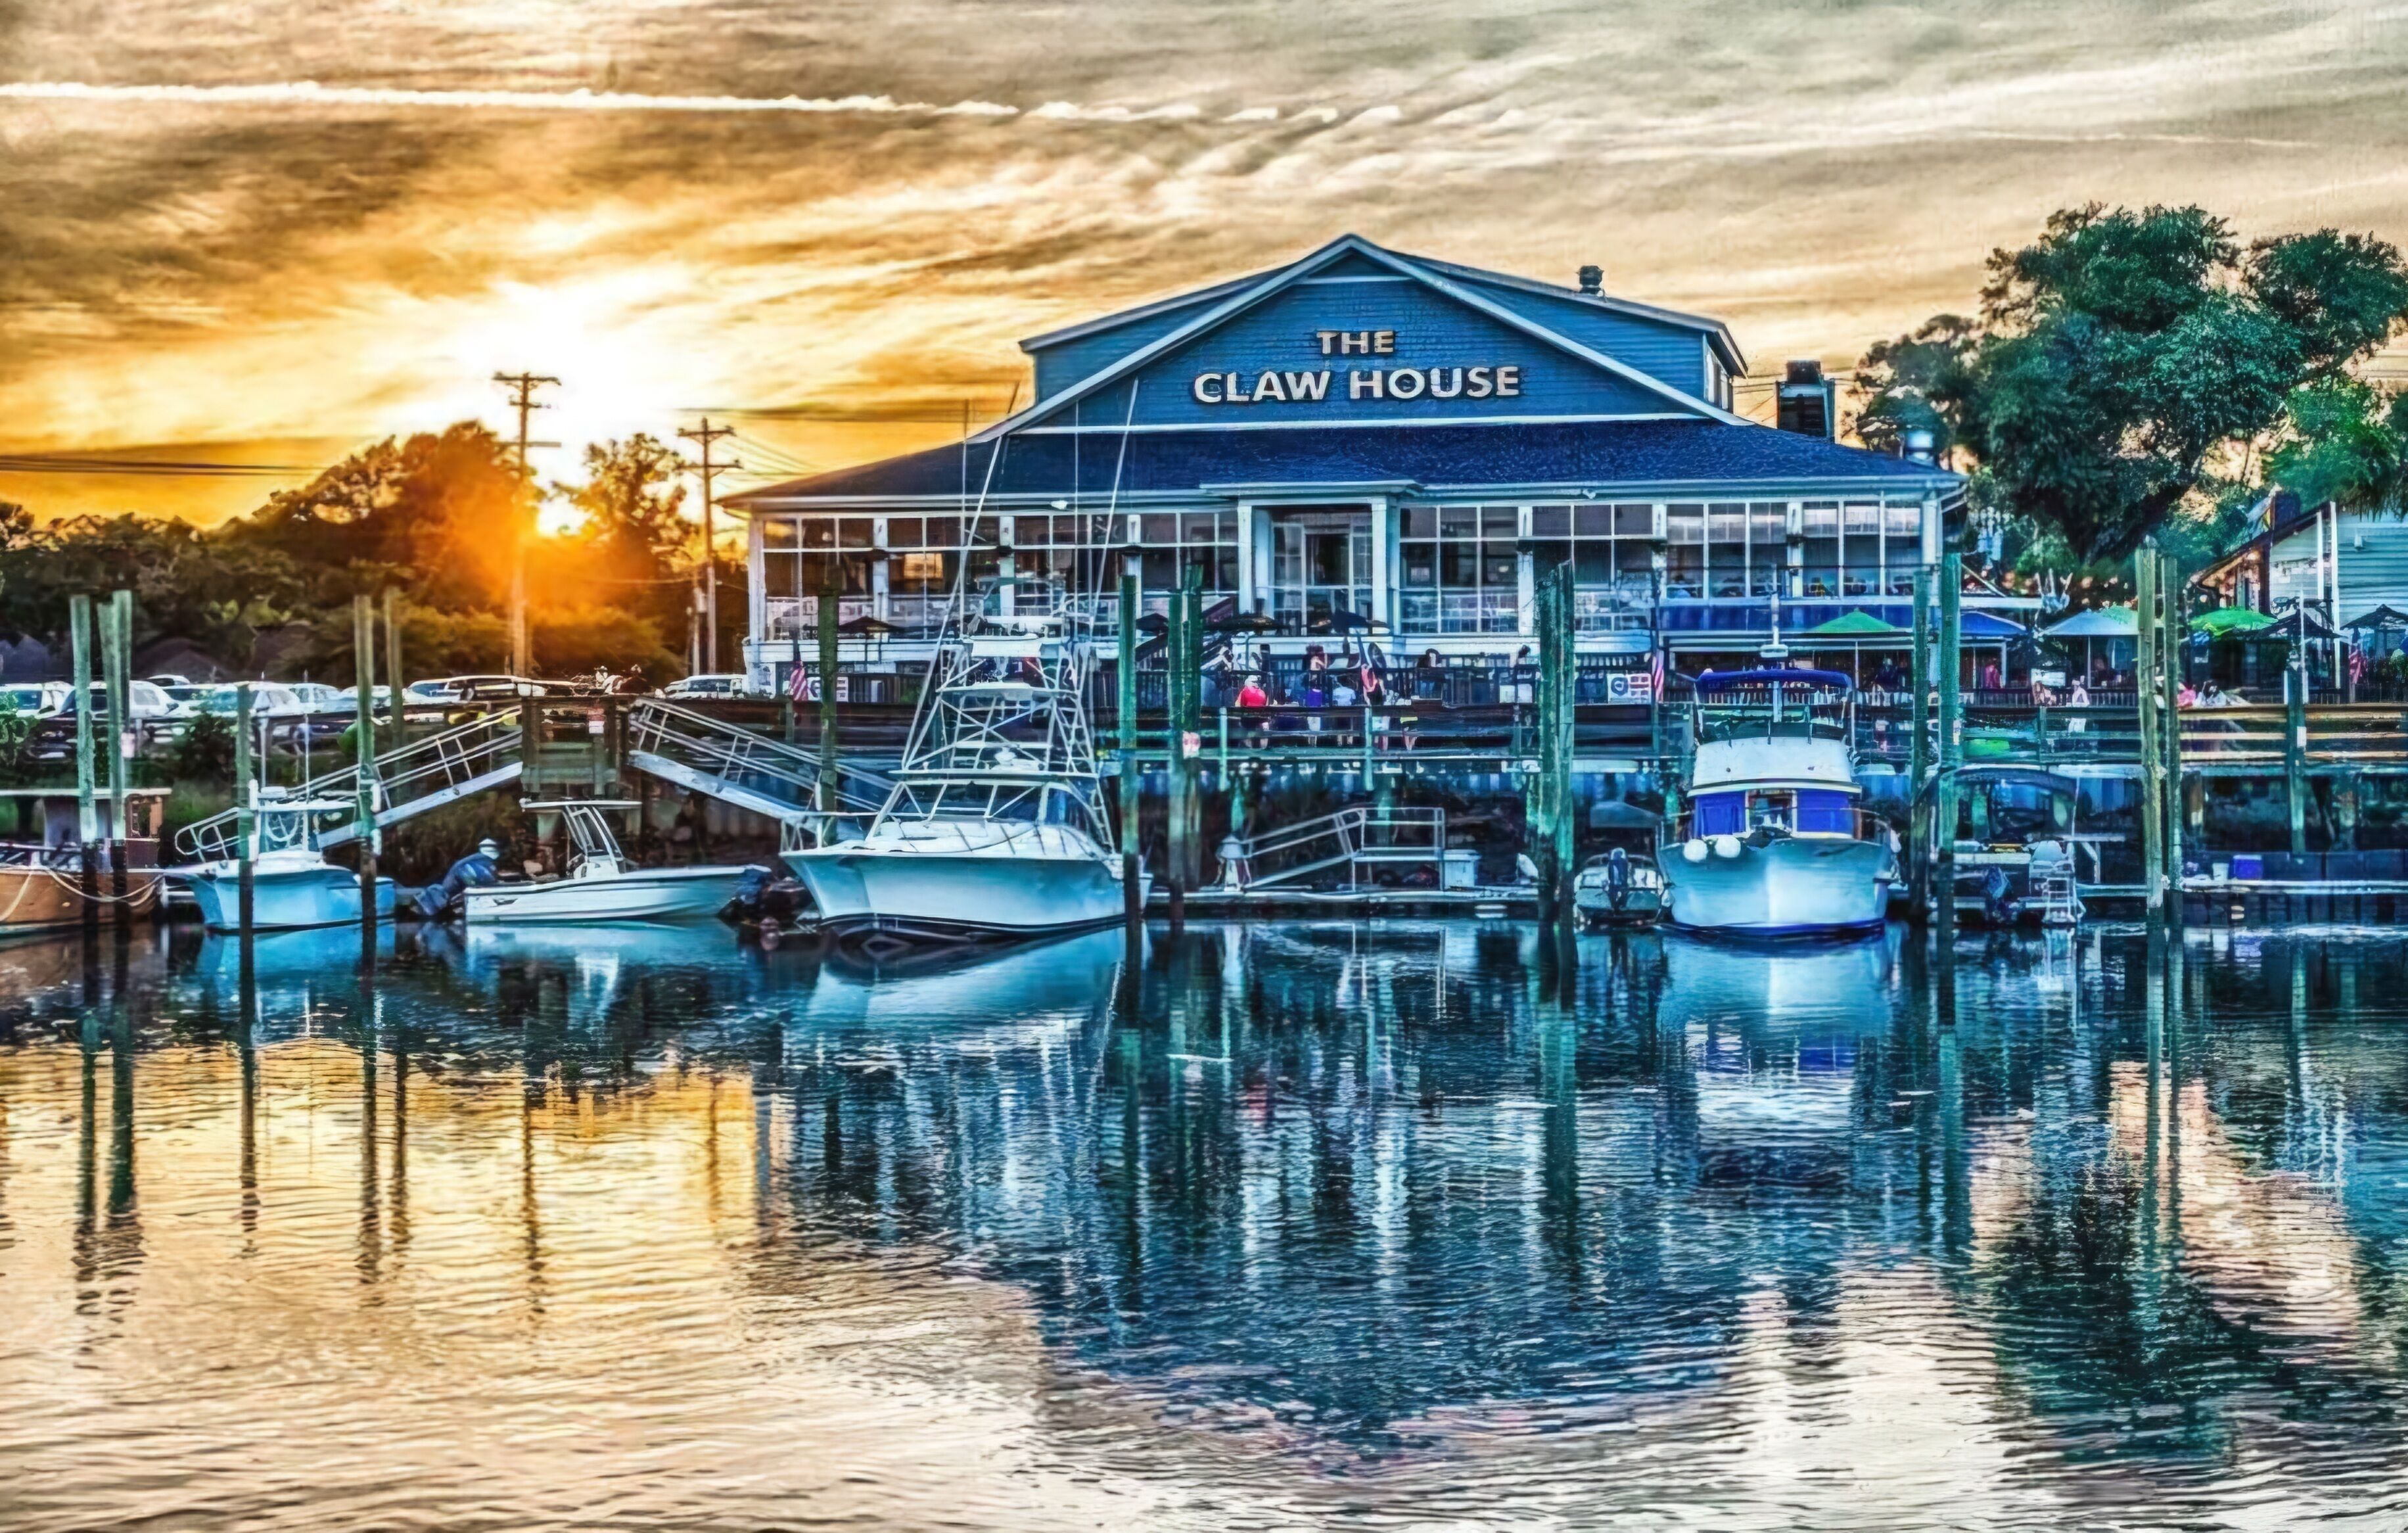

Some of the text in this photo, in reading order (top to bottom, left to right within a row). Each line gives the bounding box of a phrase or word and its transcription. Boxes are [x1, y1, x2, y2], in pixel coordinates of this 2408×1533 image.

[1316, 331, 1394, 354] THE
[1194, 366, 1519, 403] CLAW HOUSE
